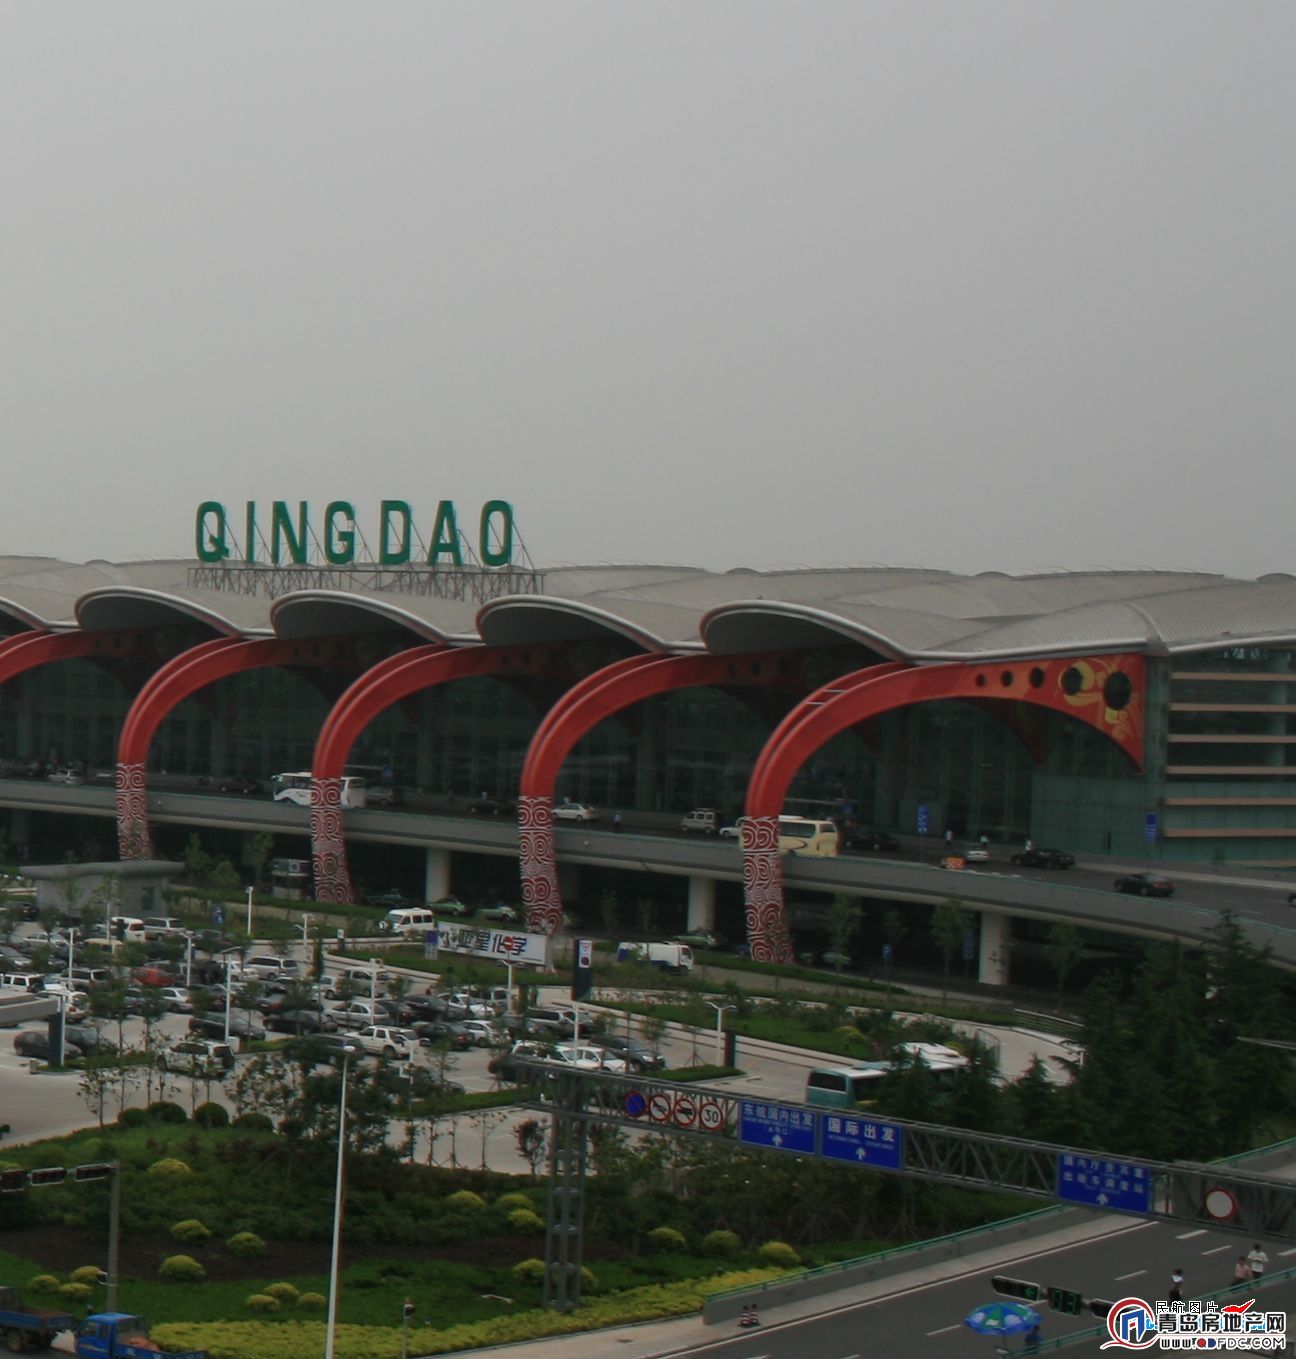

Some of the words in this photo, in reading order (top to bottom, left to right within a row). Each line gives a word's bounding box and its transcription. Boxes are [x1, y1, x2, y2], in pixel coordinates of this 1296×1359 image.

[195, 499, 514, 567] QINGDAO
[705, 1109, 719, 1123] 30
[828, 1117, 894, 1142] 国际出发
